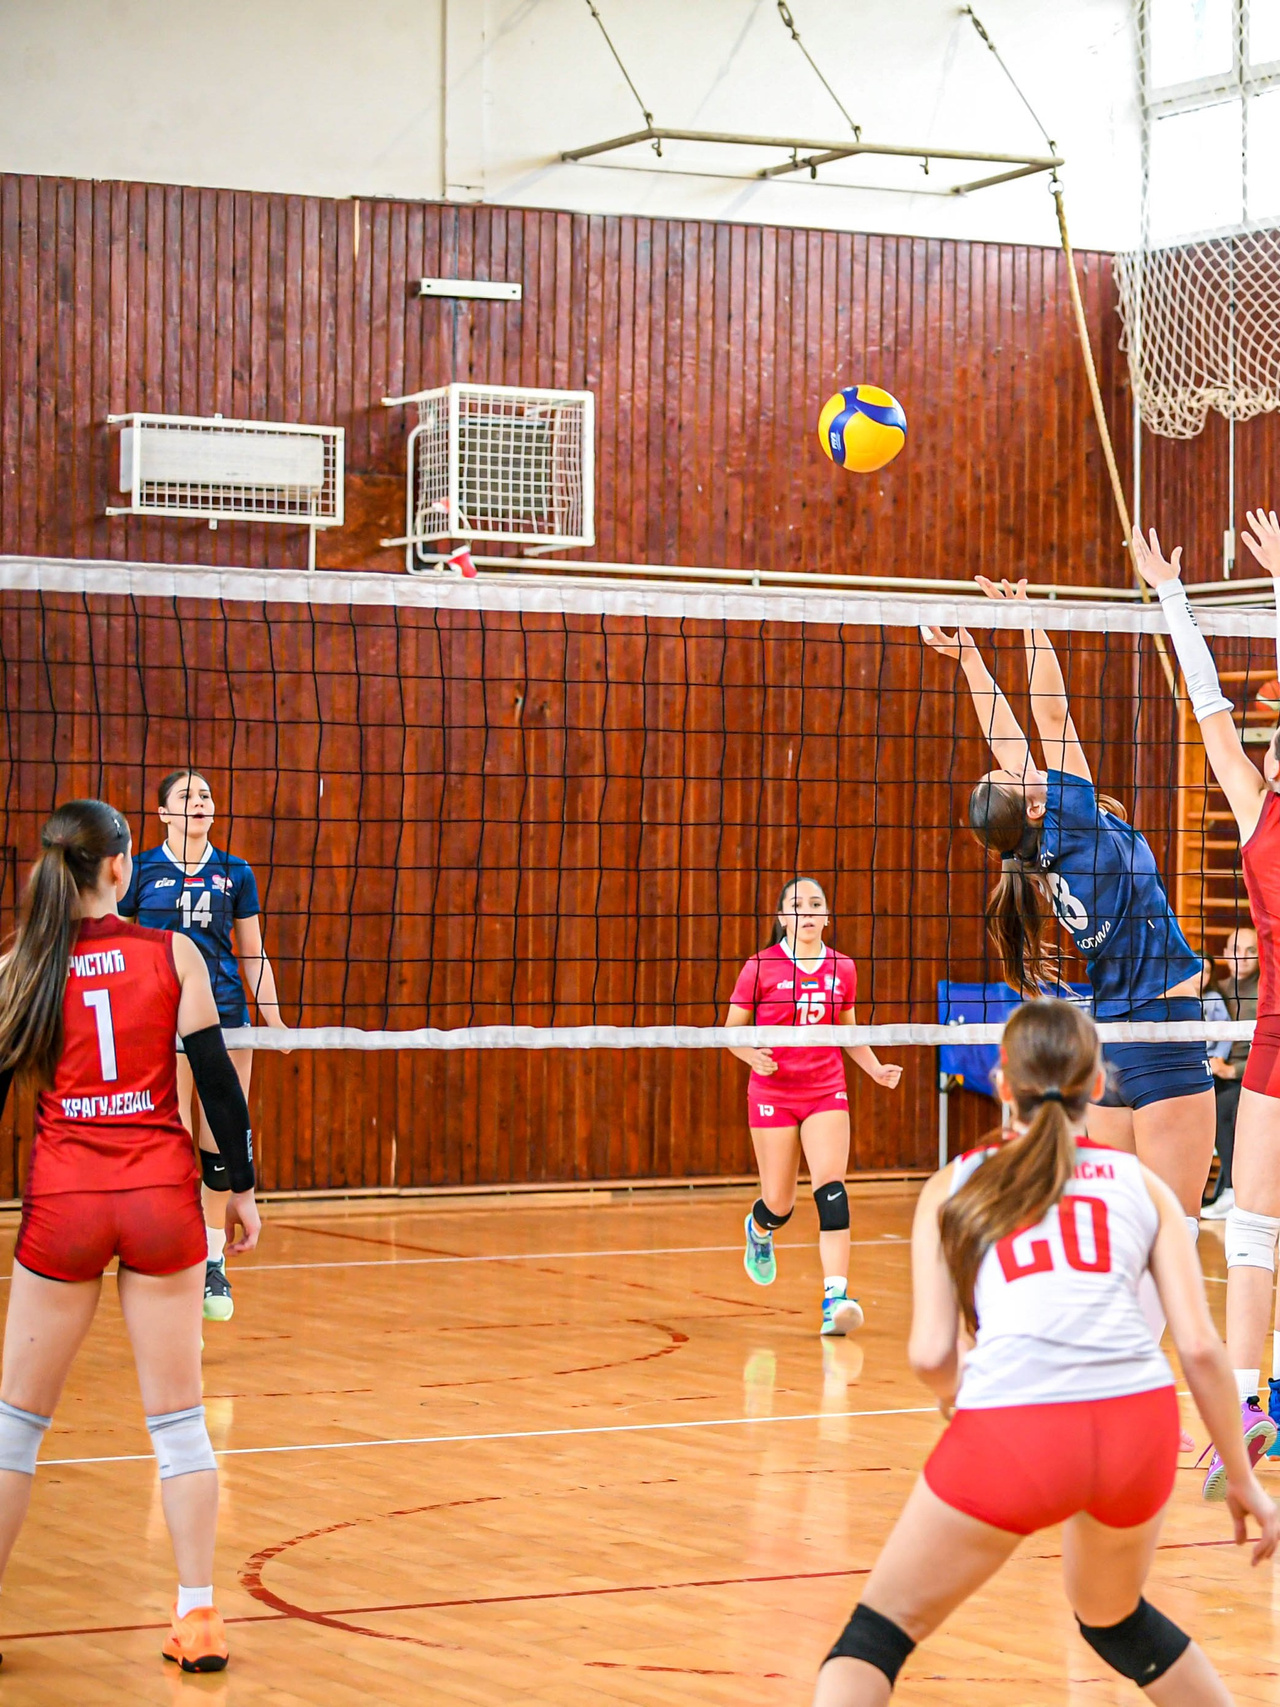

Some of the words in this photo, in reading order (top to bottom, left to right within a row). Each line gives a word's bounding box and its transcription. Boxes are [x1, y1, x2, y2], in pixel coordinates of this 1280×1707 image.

[176, 890, 213, 928] 14
[796, 992, 827, 1025] 15
[83, 989, 118, 1081] 1
[61, 1089, 155, 1119] КРАГУЈЕВАЦ
[757, 1103, 775, 1117] 15
